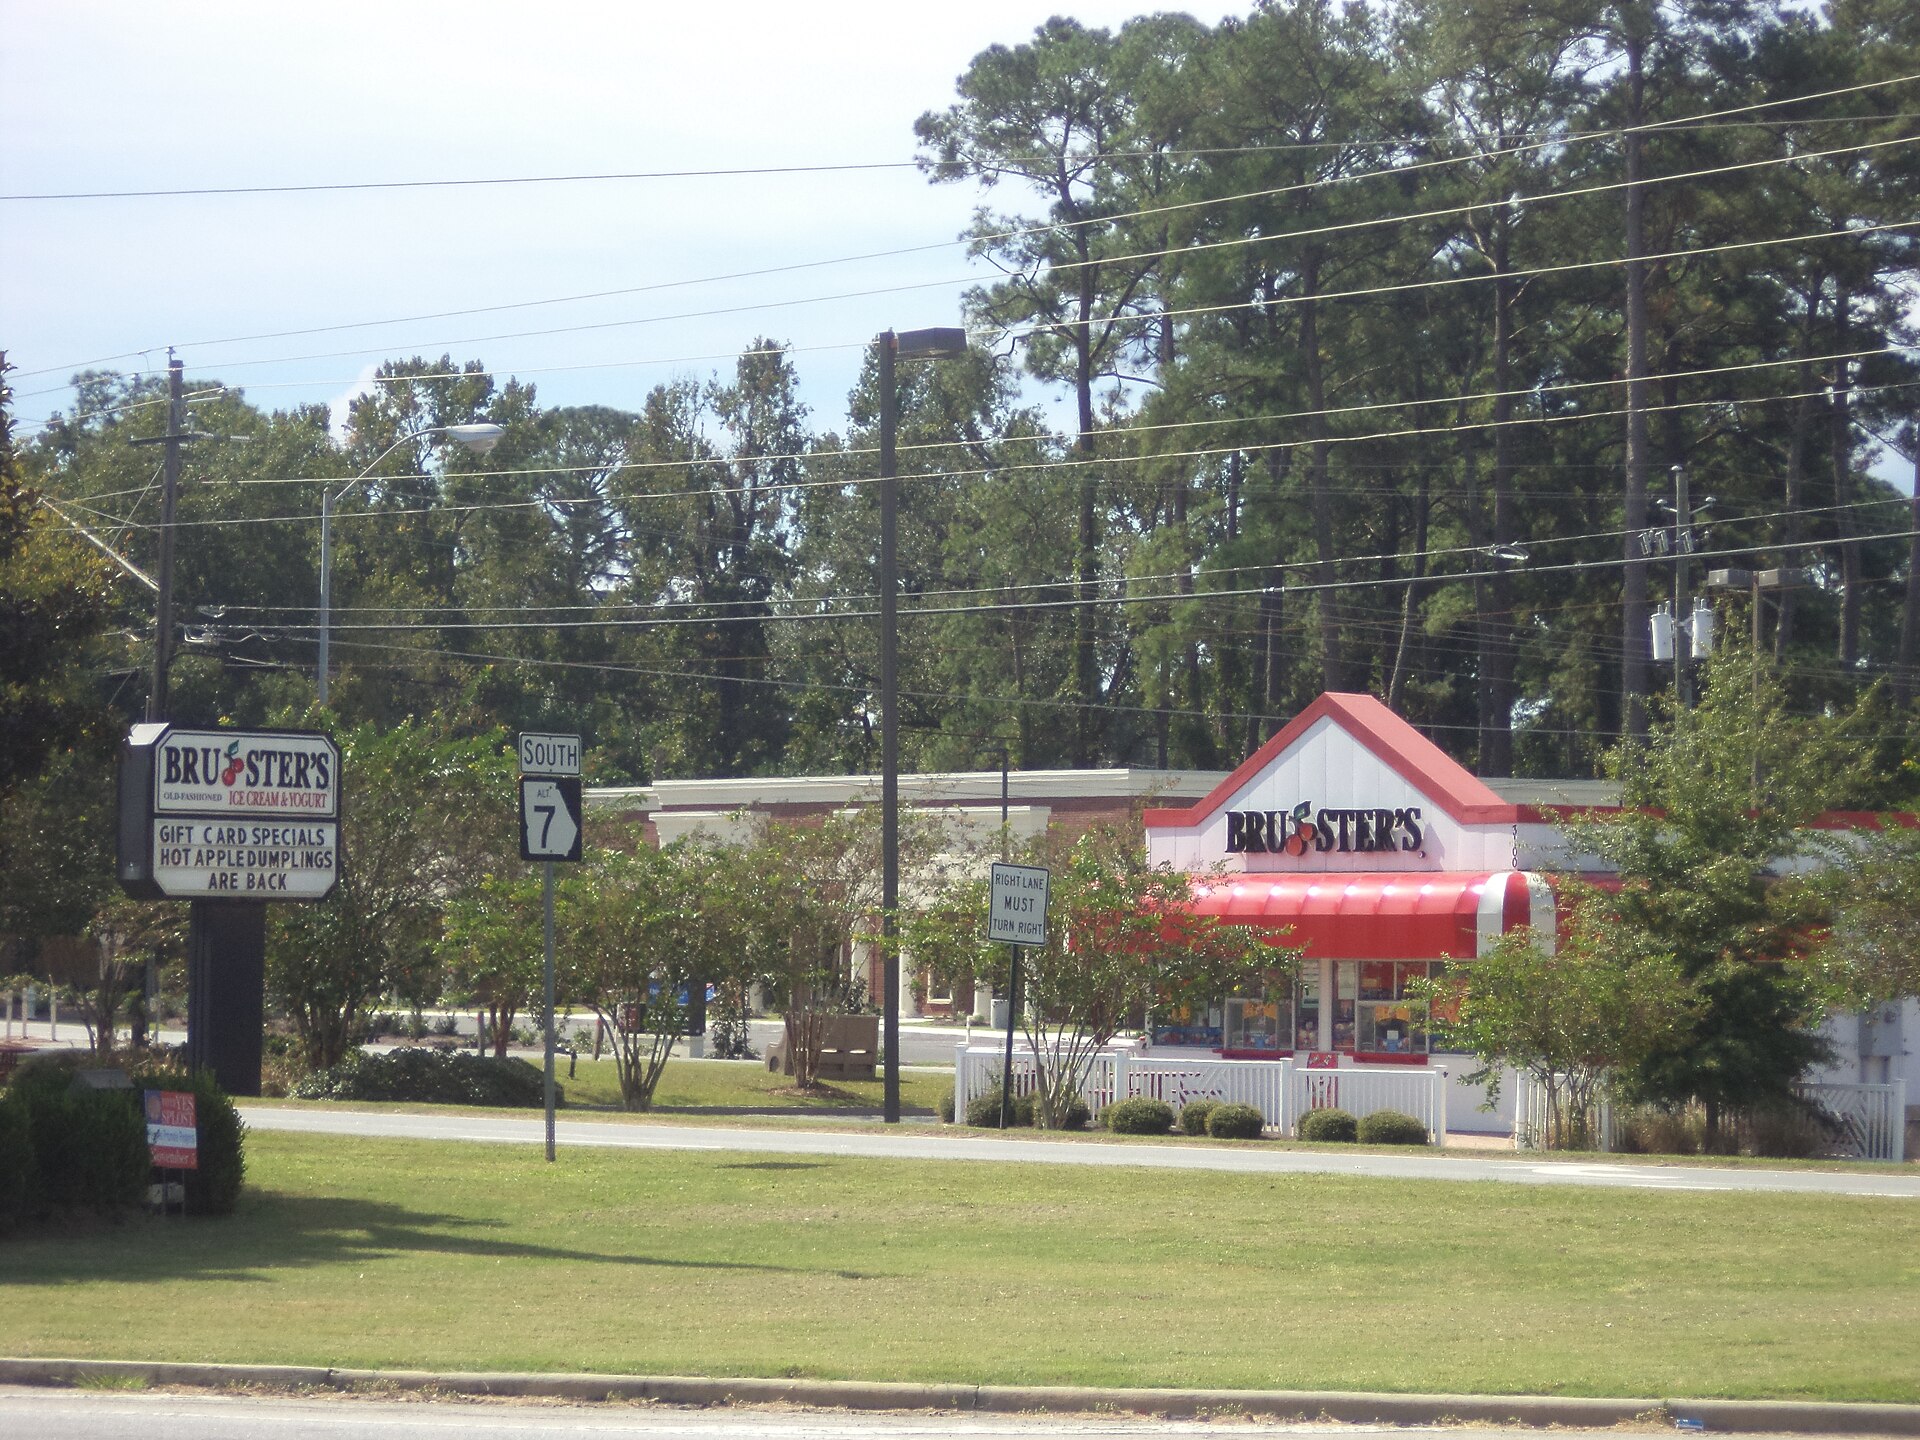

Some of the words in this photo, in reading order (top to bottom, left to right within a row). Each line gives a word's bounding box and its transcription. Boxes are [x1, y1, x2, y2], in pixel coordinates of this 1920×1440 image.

[524, 739, 577, 766] SOUTH
[164, 746, 330, 789] BRUSTER'S
[163, 792, 222, 802] OLD-FASHIONED
[229, 791, 245, 806] ICE
[247, 791, 279, 807] CREAM
[280, 793, 288, 806] &
[289, 793, 328, 808] YOGURT
[160, 825, 193, 844] GIFT
[204, 826, 247, 845] CARD
[252, 828, 325, 846] SPECIALS
[534, 805, 556, 849] 7
[1225, 808, 1422, 853] BRUSTER'S
[160, 848, 191, 866] HOT
[195, 849, 245, 867] APPLE
[249, 850, 333, 869] DUMPLINGS
[208, 872, 238, 889] ARE
[247, 873, 287, 890] BACK
[995, 873, 1020, 887] RIGHT
[1022, 877, 1045, 890] LANE
[1004, 896, 1035, 912] MUST
[993, 919, 1015, 932] TURN
[1018, 922, 1042, 935] RIGHT
[175, 1095, 194, 1111] YES
